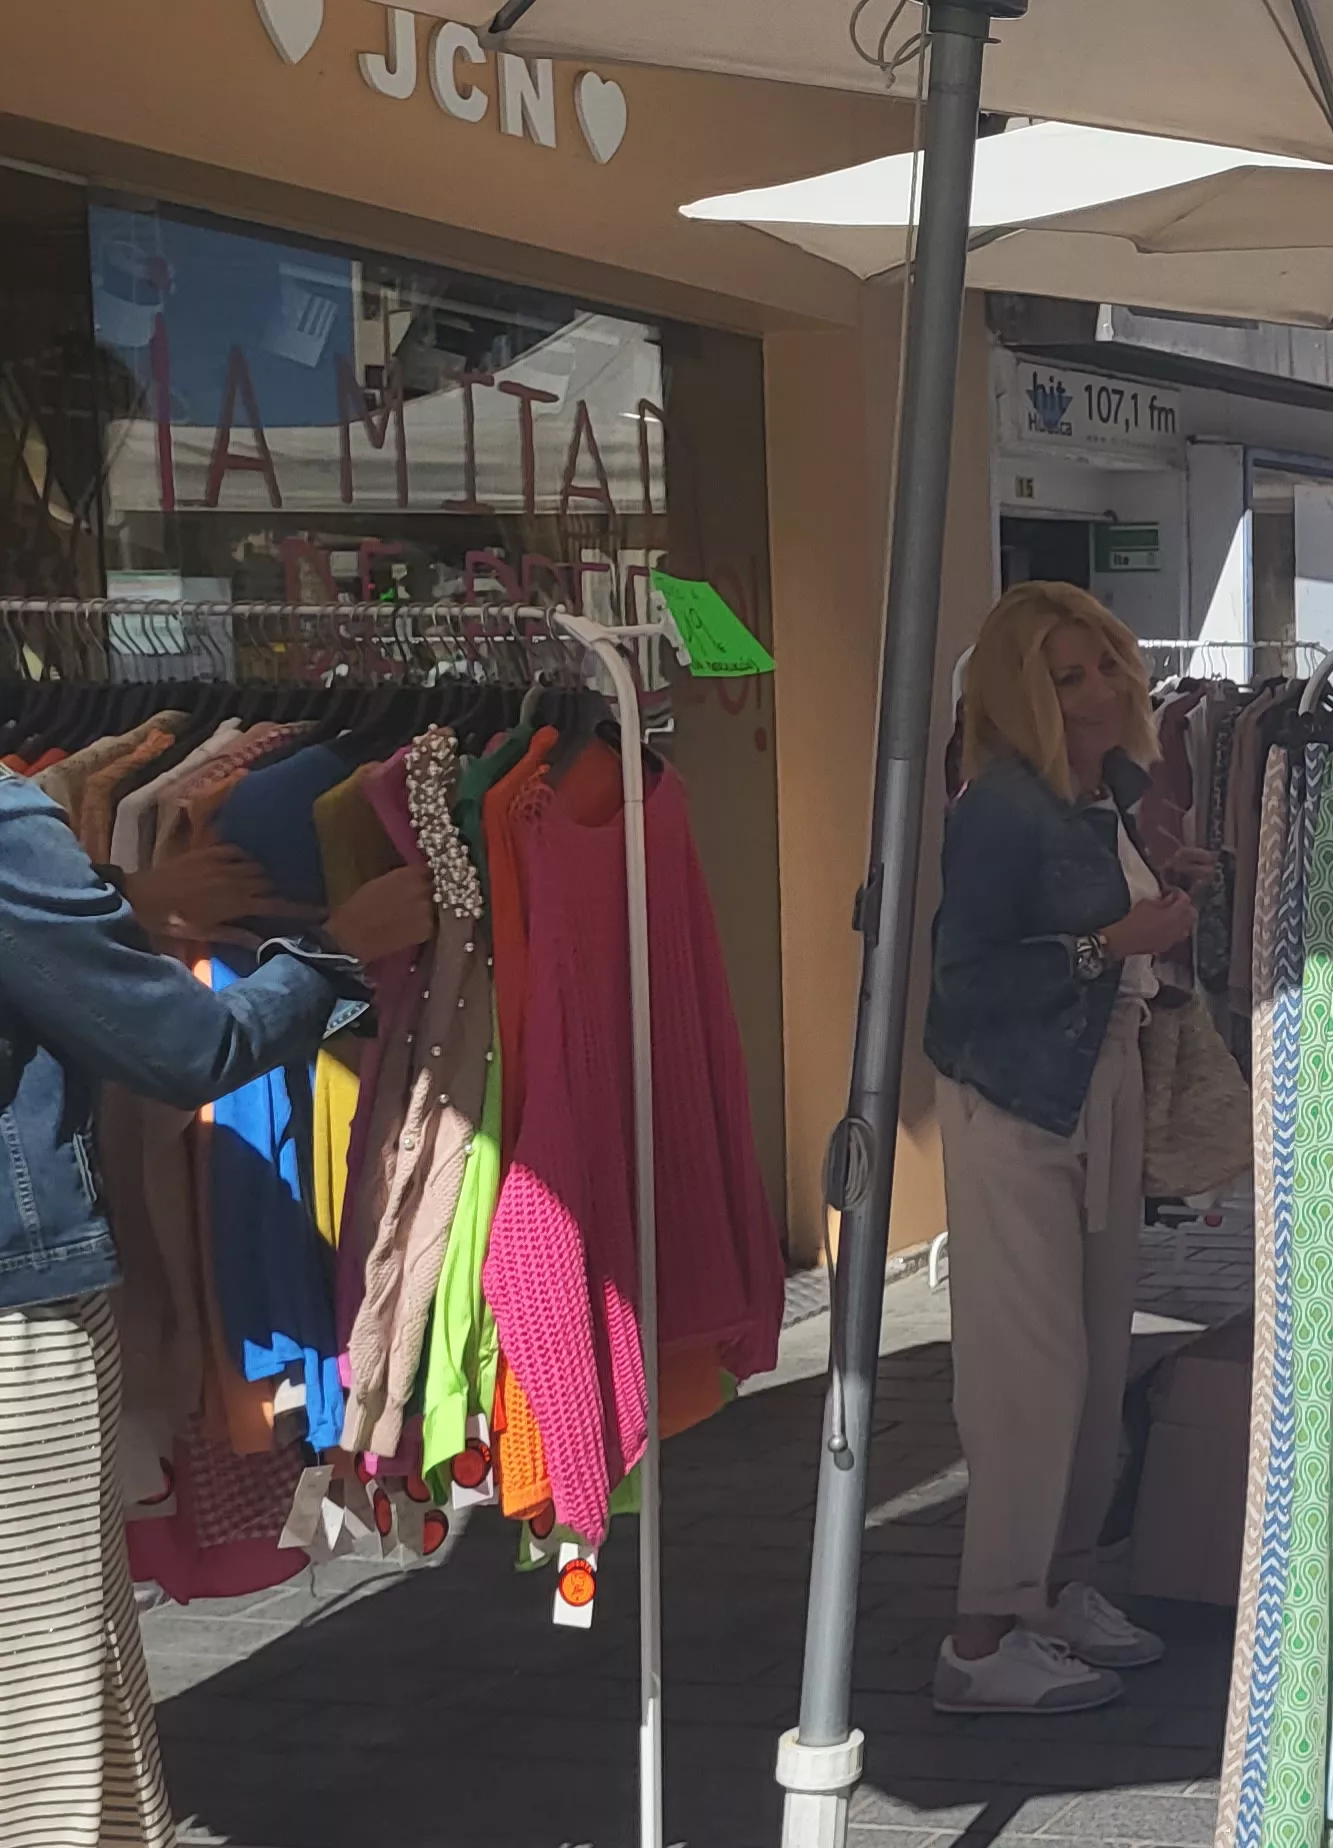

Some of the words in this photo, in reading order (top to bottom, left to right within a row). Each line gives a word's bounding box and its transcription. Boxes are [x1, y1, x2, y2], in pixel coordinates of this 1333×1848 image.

[358, 8, 556, 148] JCN
[1085, 384, 1139, 433] 107,1
[1149, 395, 1175, 433] fm
